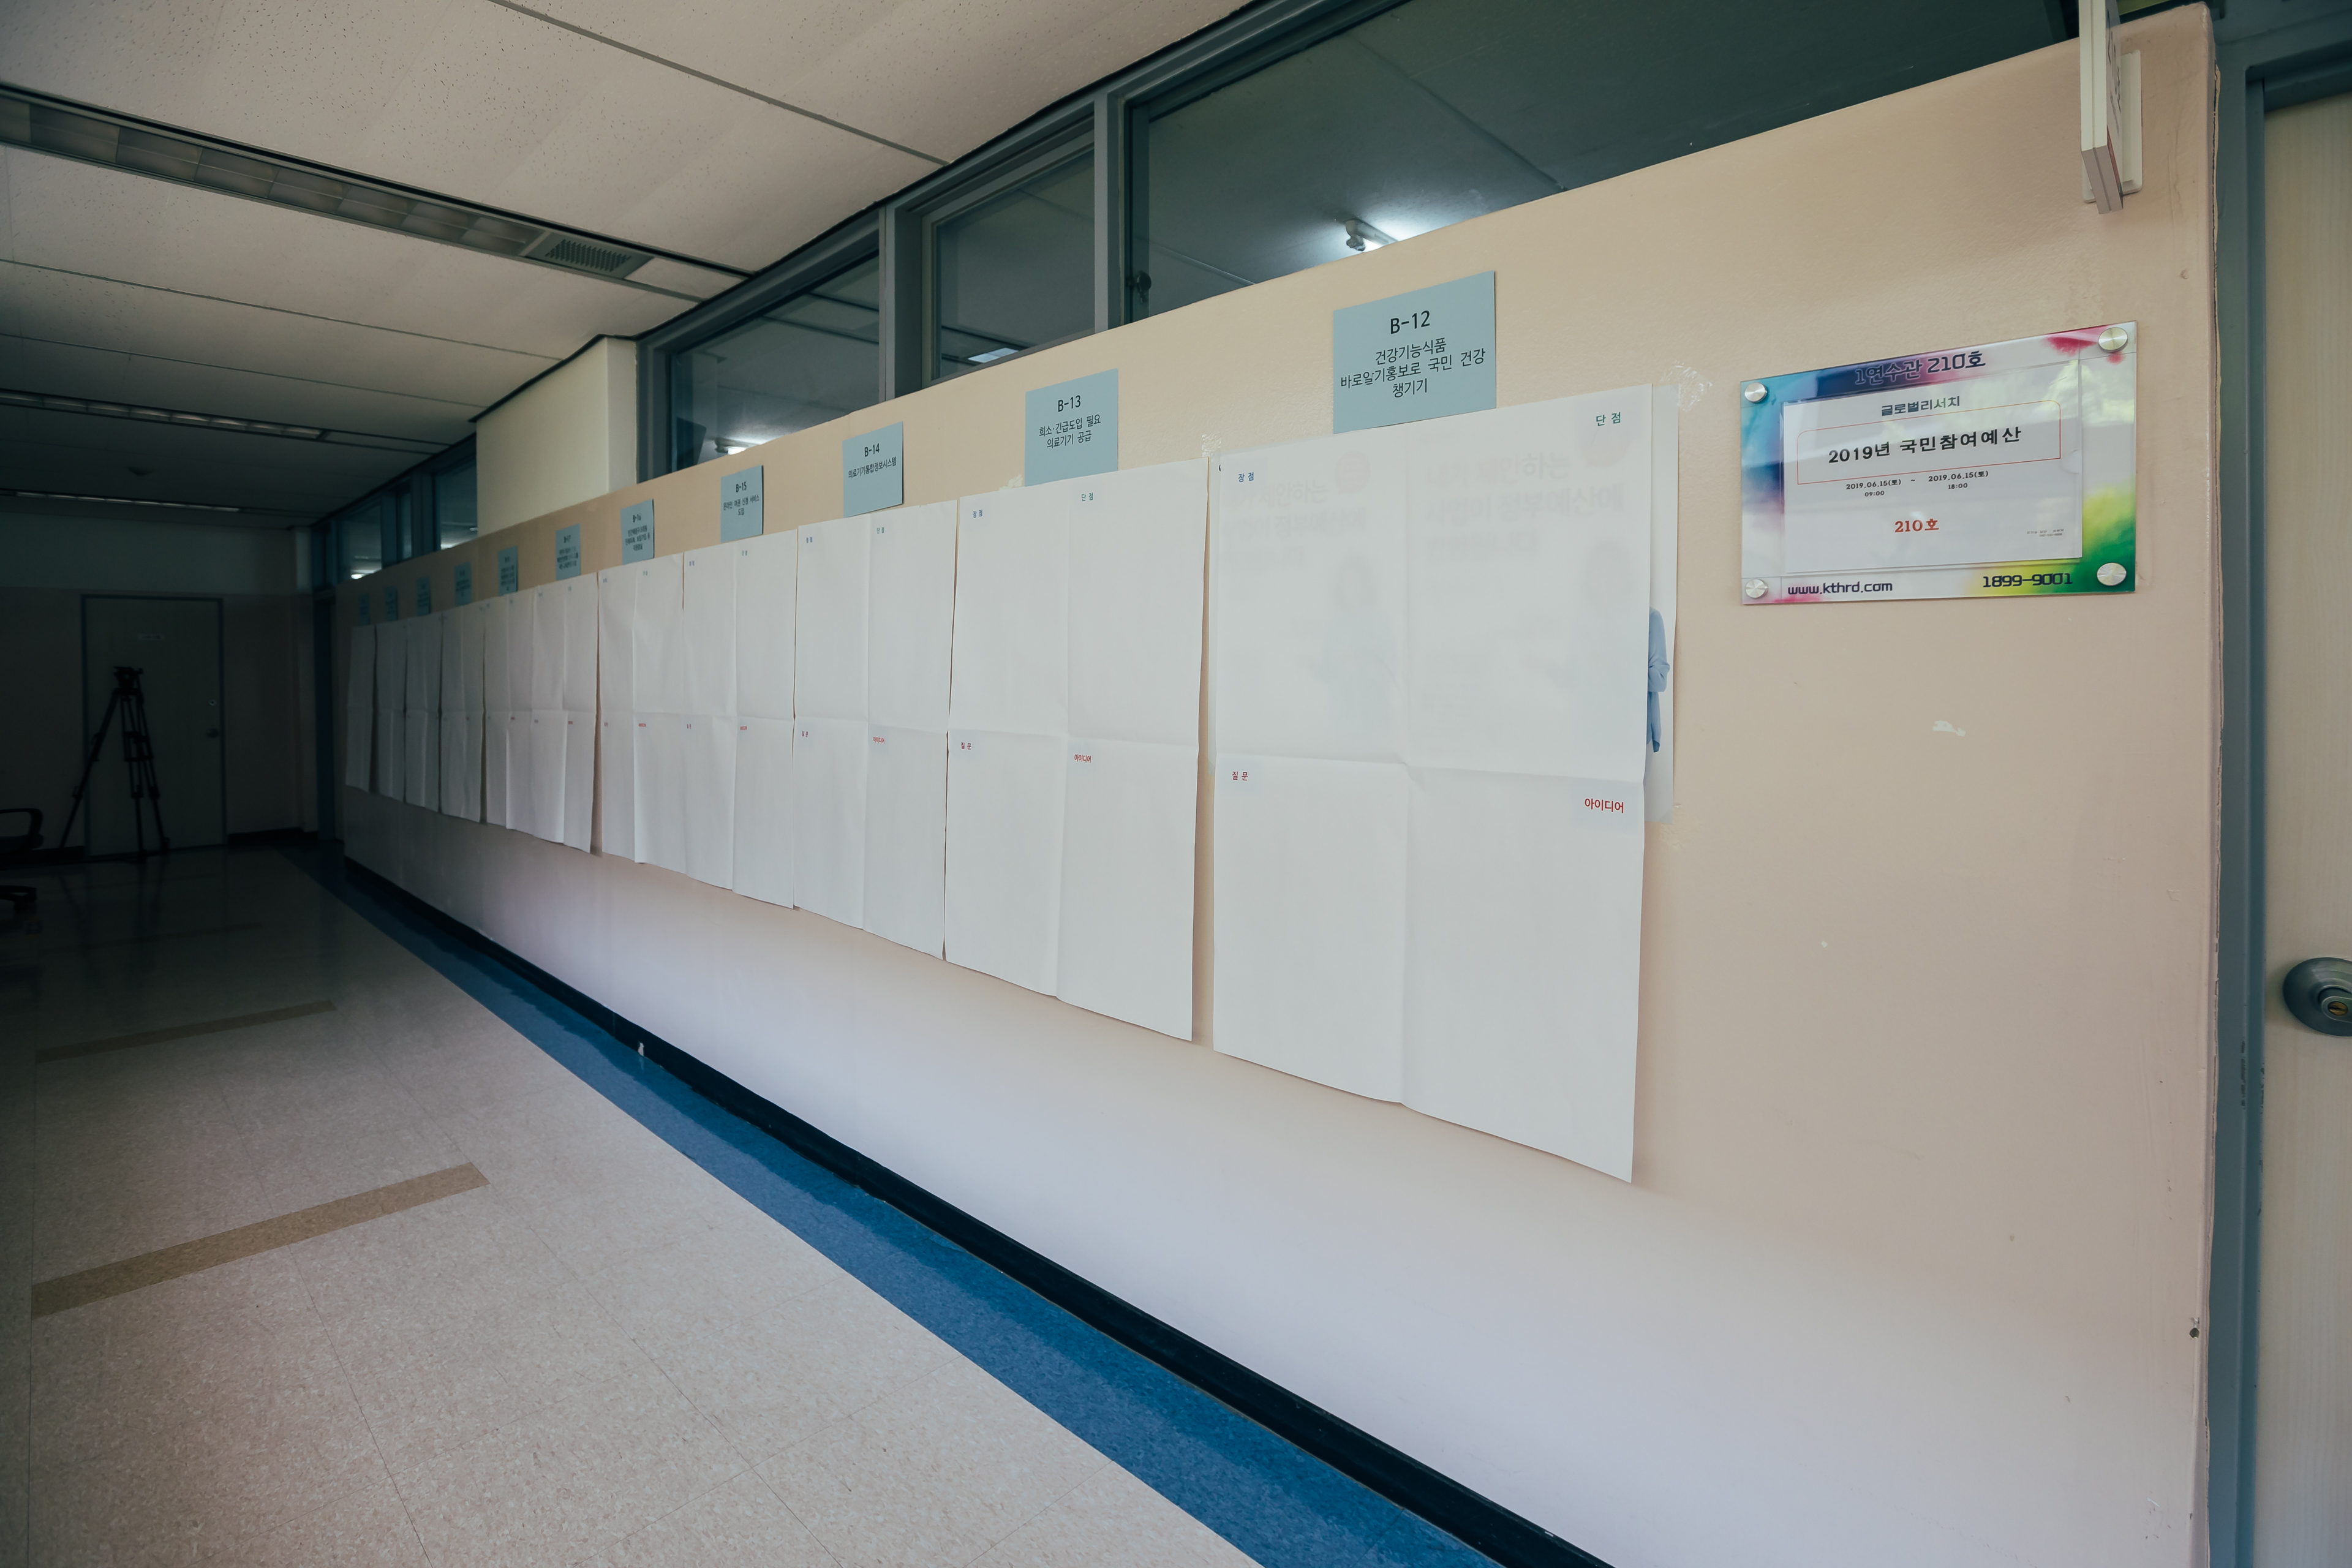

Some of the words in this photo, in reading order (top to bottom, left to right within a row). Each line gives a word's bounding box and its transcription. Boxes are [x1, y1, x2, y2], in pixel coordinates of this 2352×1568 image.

[1390, 310, 1430, 334] B-12
[1375, 337, 1447, 366] 건강기능식품
[1341, 362, 1422, 389] 바로알기홍보로
[1428, 354, 1452, 372] 국민
[1460, 347, 1486, 367] 건강
[1855, 360, 1923, 385] 1연수관
[1928, 350, 1986, 373] 210호
[1392, 378, 1428, 398] 챙기기
[1058, 395, 1081, 412] B-13
[1881, 396, 1960, 417] 글로벌리서치
[1086, 414, 1101, 428] 필요
[1046, 433, 1074, 449] 의료기기
[1077, 430, 1092, 443] 공급
[1829, 442, 1890, 464] 2019년
[1899, 426, 2022, 454] 국민참여예산
[864, 443, 880, 457] B-14
[736, 481, 747, 493] B-15
[1846, 478, 1902, 489] 2019.06.15(토)
[1928, 470, 1989, 482] 2019.06.15(토)
[1894, 518, 1940, 532] 210호
[1787, 581, 1893, 595] www.kthrd.com
[1983, 573, 2073, 588] 1899-9001
[1074, 753, 1091, 764] 아이디어
[1585, 798, 1624, 814] 아이디어
